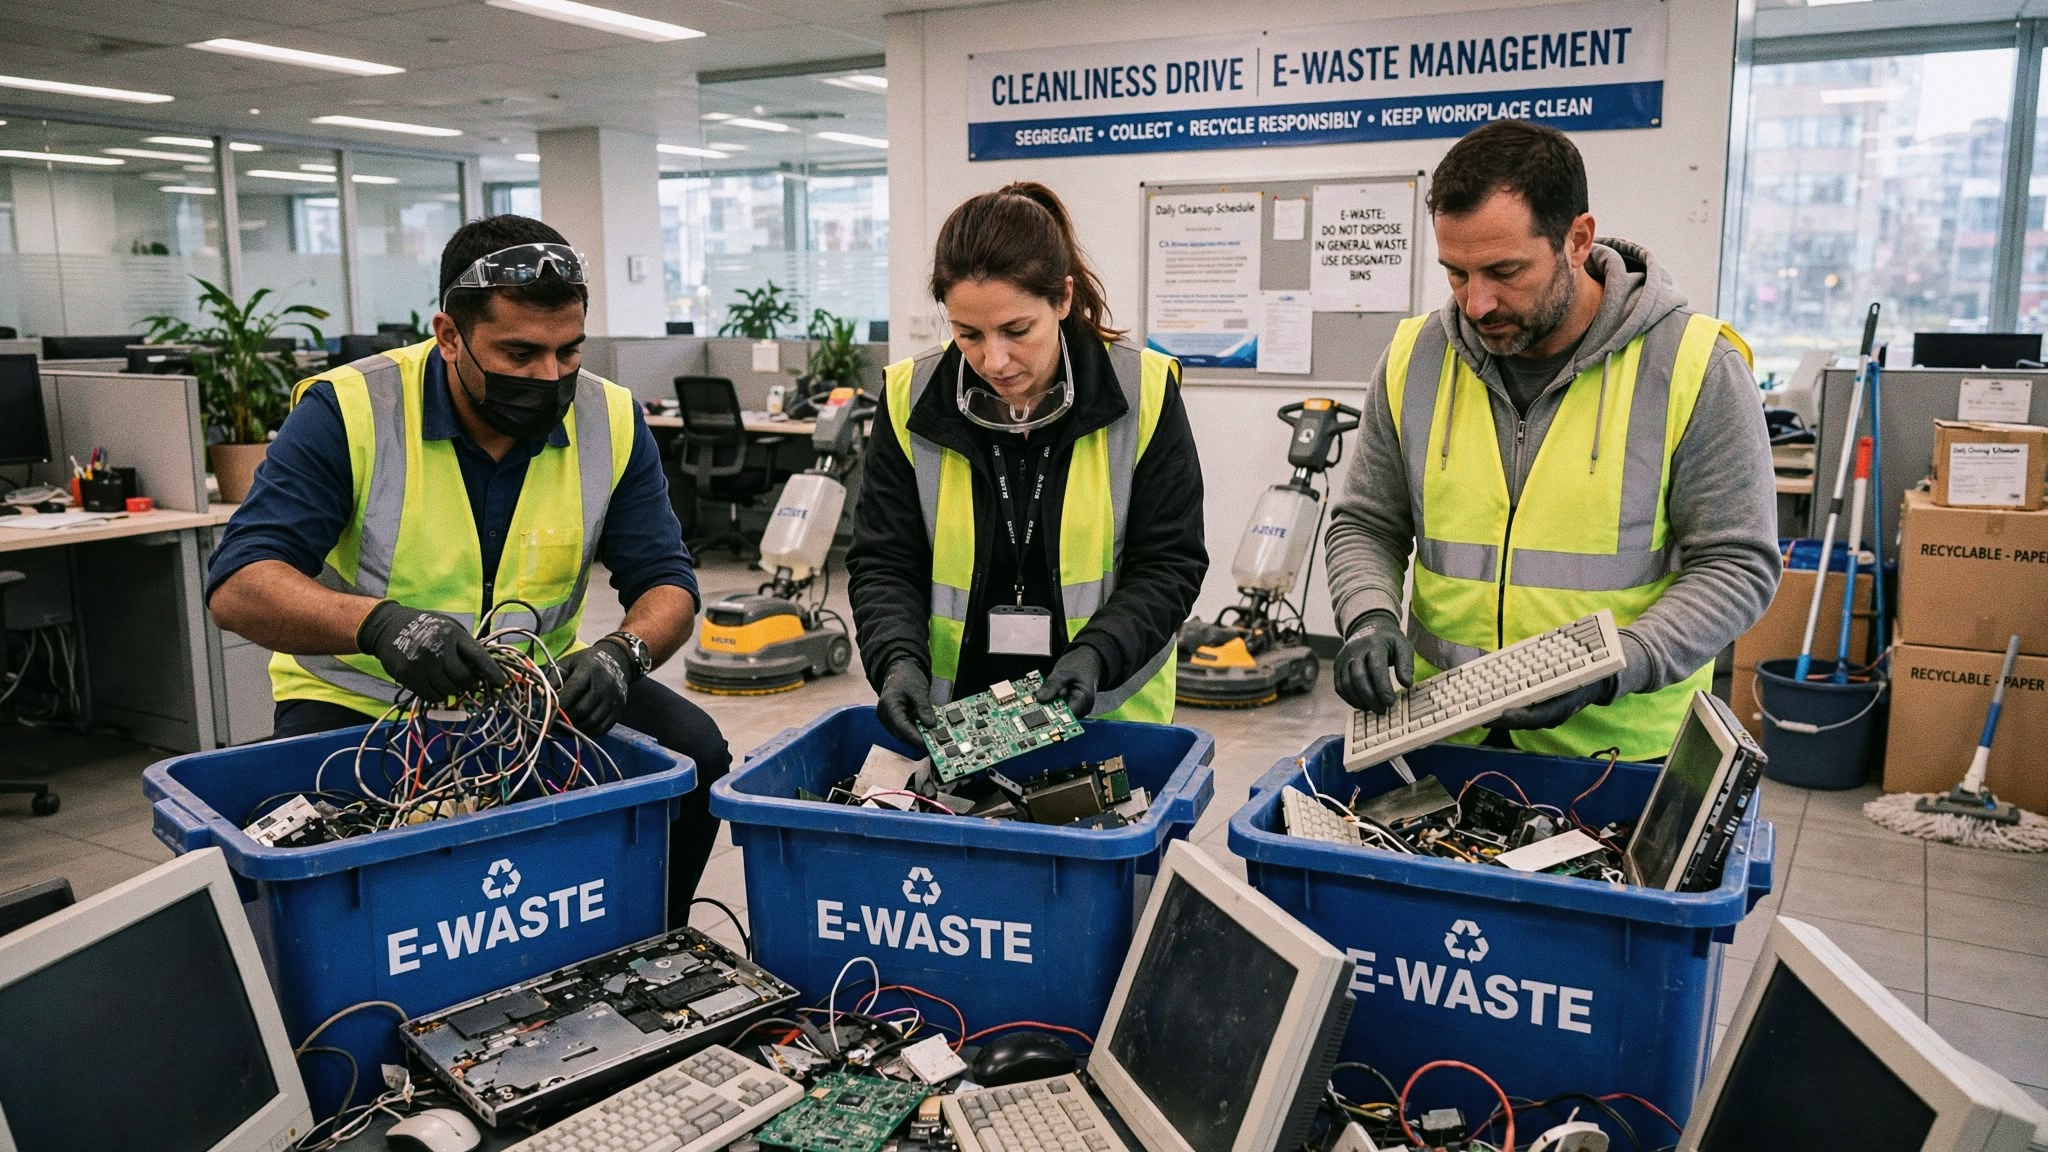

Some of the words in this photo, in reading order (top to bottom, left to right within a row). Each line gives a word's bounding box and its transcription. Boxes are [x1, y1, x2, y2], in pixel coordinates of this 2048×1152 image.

[992, 64, 1157, 106] CLEANLINESS
[1166, 57, 1244, 95] DRIVE
[1273, 45, 1400, 87] E-WASTE
[1409, 27, 1632, 78] MANAGEMENT
[1015, 126, 1094, 146] SEGREGATE
[1109, 121, 1173, 141] COLLECT
[1189, 116, 1255, 137] RECYCLE
[1258, 110, 1362, 133] RESPONSIBLY
[1381, 107, 1423, 127] KEEP
[1426, 101, 1531, 124] WORKPLACE
[1534, 97, 1593, 118] CLEAN
[1156, 204, 1175, 218] Daily
[1178, 203, 1214, 216] Cleanup
[1216, 202, 1255, 213] Schedule
[1341, 208, 1386, 220] E-WASTE:
[1321, 225, 1336, 236] DO
[1339, 224, 1358, 235] NOT
[1361, 223, 1402, 235] DISPOSE
[1315, 240, 1325, 251] IN
[1327, 239, 1371, 251] GENERAL
[1374, 238, 1408, 250] WASTE
[1321, 255, 1339, 266] USE
[1341, 254, 1402, 266] DESIGNATED
[1350, 269, 1371, 280] BINS
[1920, 543, 2002, 561] RECYCLABLE
[2014, 549, 2048, 564] PAPE
[1911, 667, 1992, 687] RECYCLABLE
[2003, 676, 2045, 691] PAPER
[387, 878, 606, 976] E-WASTE
[817, 899, 1033, 964] E-WASTE
[1346, 947, 1594, 1034] E-WASTE
